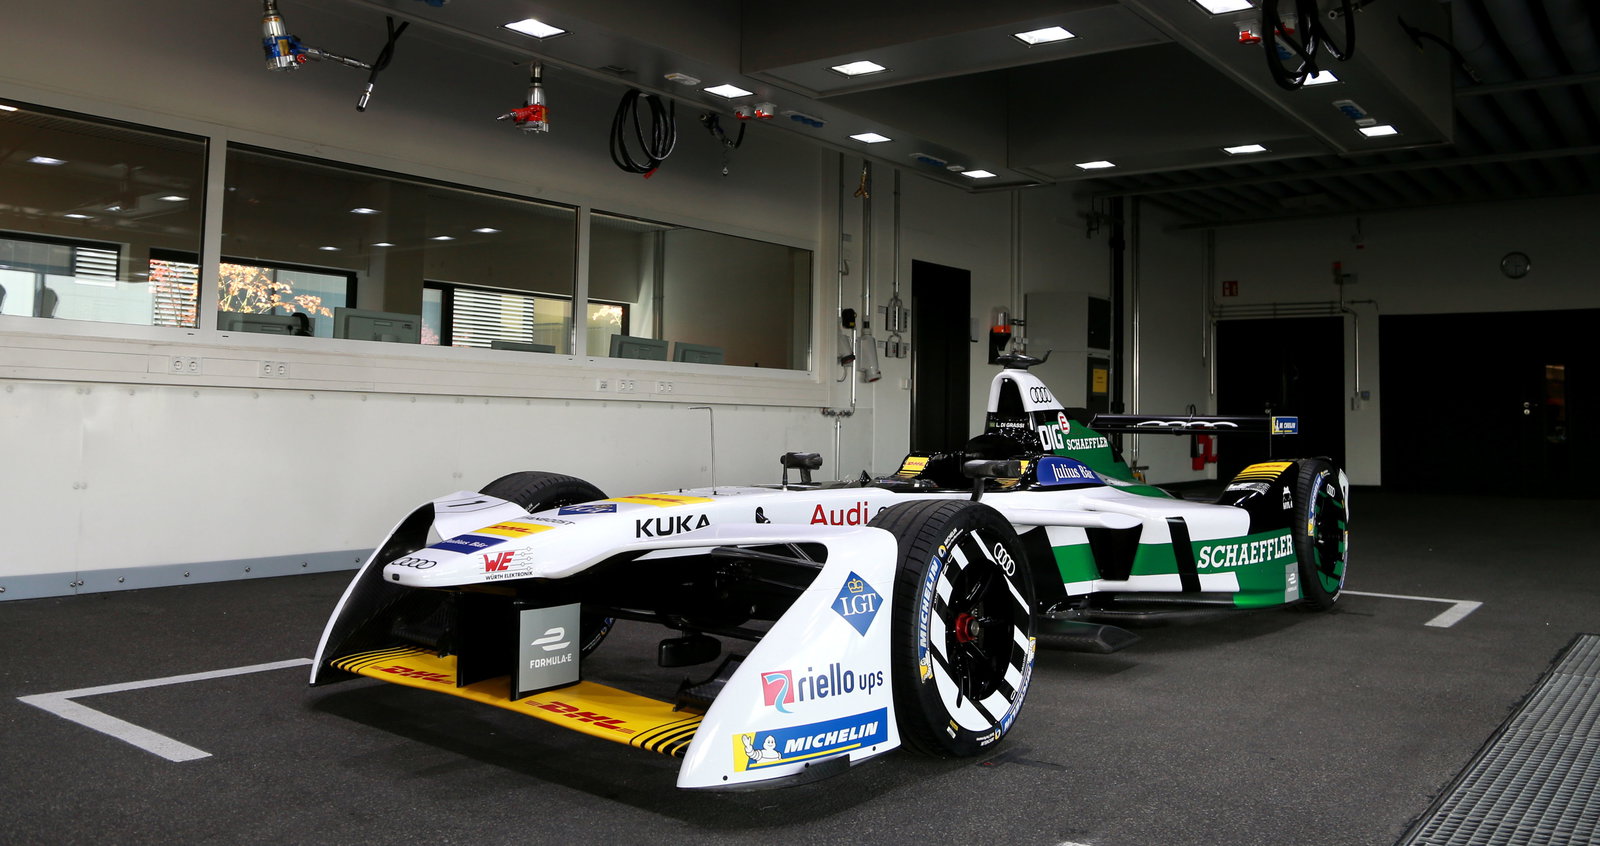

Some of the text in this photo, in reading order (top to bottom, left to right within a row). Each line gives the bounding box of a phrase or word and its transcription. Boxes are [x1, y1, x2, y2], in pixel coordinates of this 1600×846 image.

[1038, 424, 1064, 451] DIG
[1067, 437, 1108, 450] SCHAEFFLER
[1052, 464, 1079, 481] Julius
[810, 501, 868, 526] Audi
[636, 514, 710, 538] KUKA
[483, 551, 515, 572] WE
[1197, 534, 1293, 569] SCHAEFFLER
[485, 573, 503, 581] WÜRTH
[840, 593, 876, 616] LGT
[920, 559, 940, 648] MICHELIN
[381, 665, 450, 684] DHL
[798, 662, 883, 702] riello ups
[540, 701, 625, 730] DHL
[784, 721, 879, 753] MICHELIN
